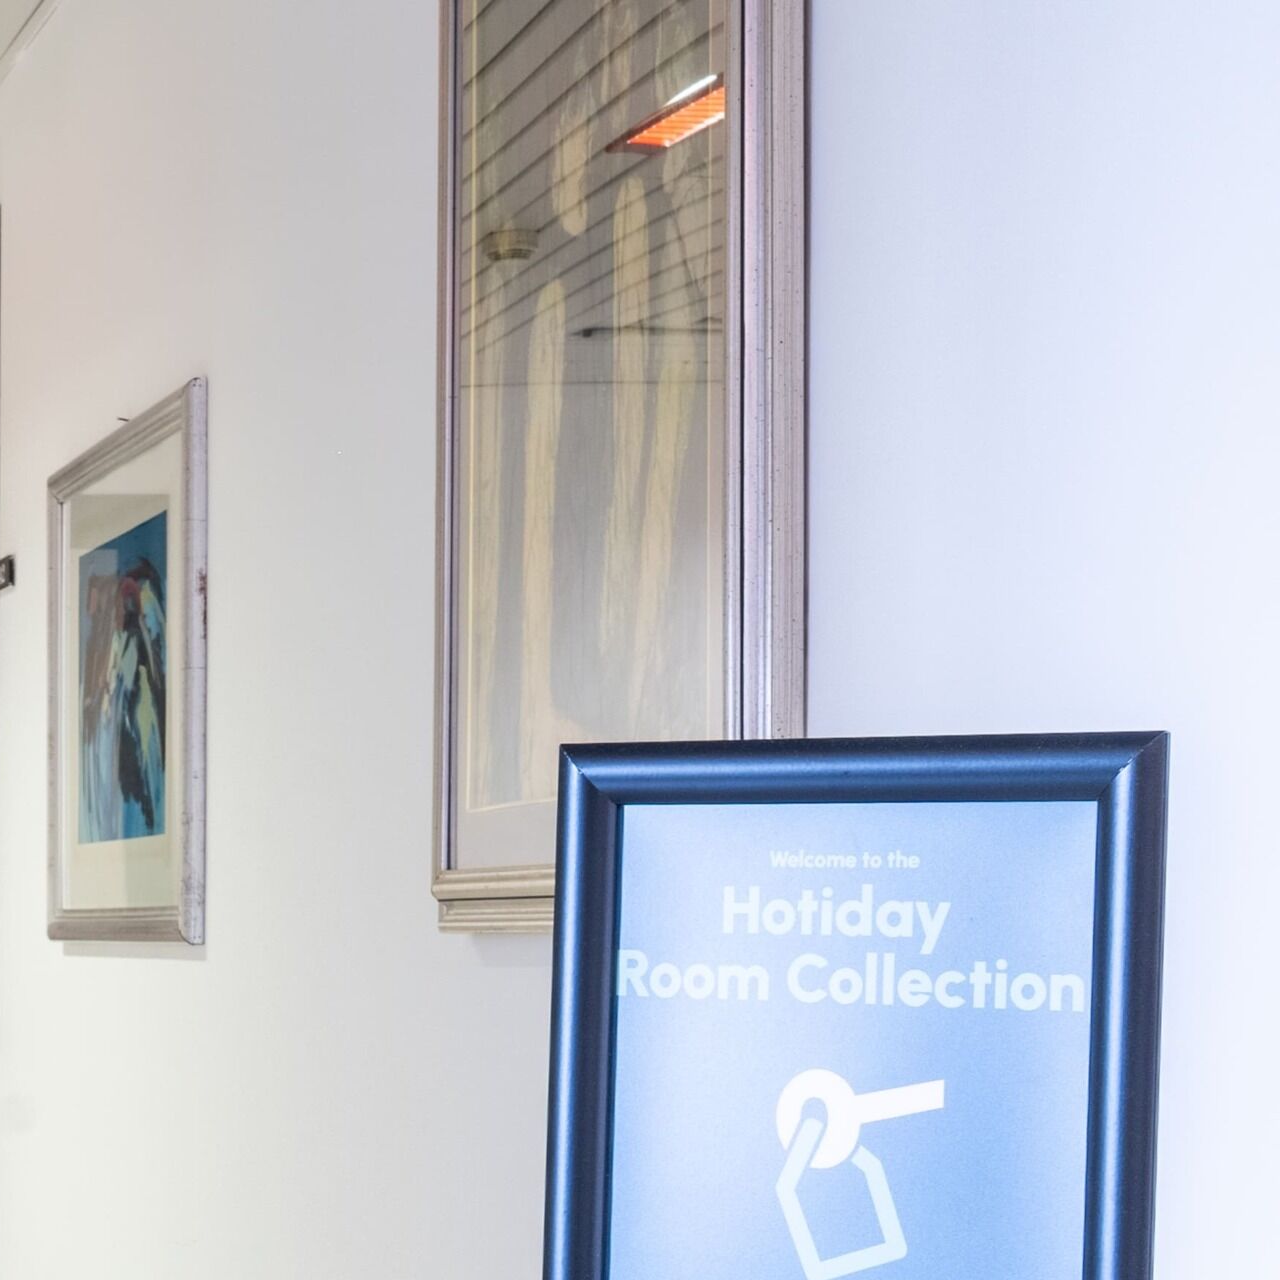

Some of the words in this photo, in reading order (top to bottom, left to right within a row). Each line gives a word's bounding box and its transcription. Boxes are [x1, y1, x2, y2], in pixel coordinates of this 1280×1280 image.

[769, 850, 858, 869] Welcome
[862, 851, 882, 869] to
[887, 850, 921, 869] the
[721, 883, 952, 955] Hotiday
[616, 948, 770, 1001] Room
[786, 951, 1086, 1013] Collection
